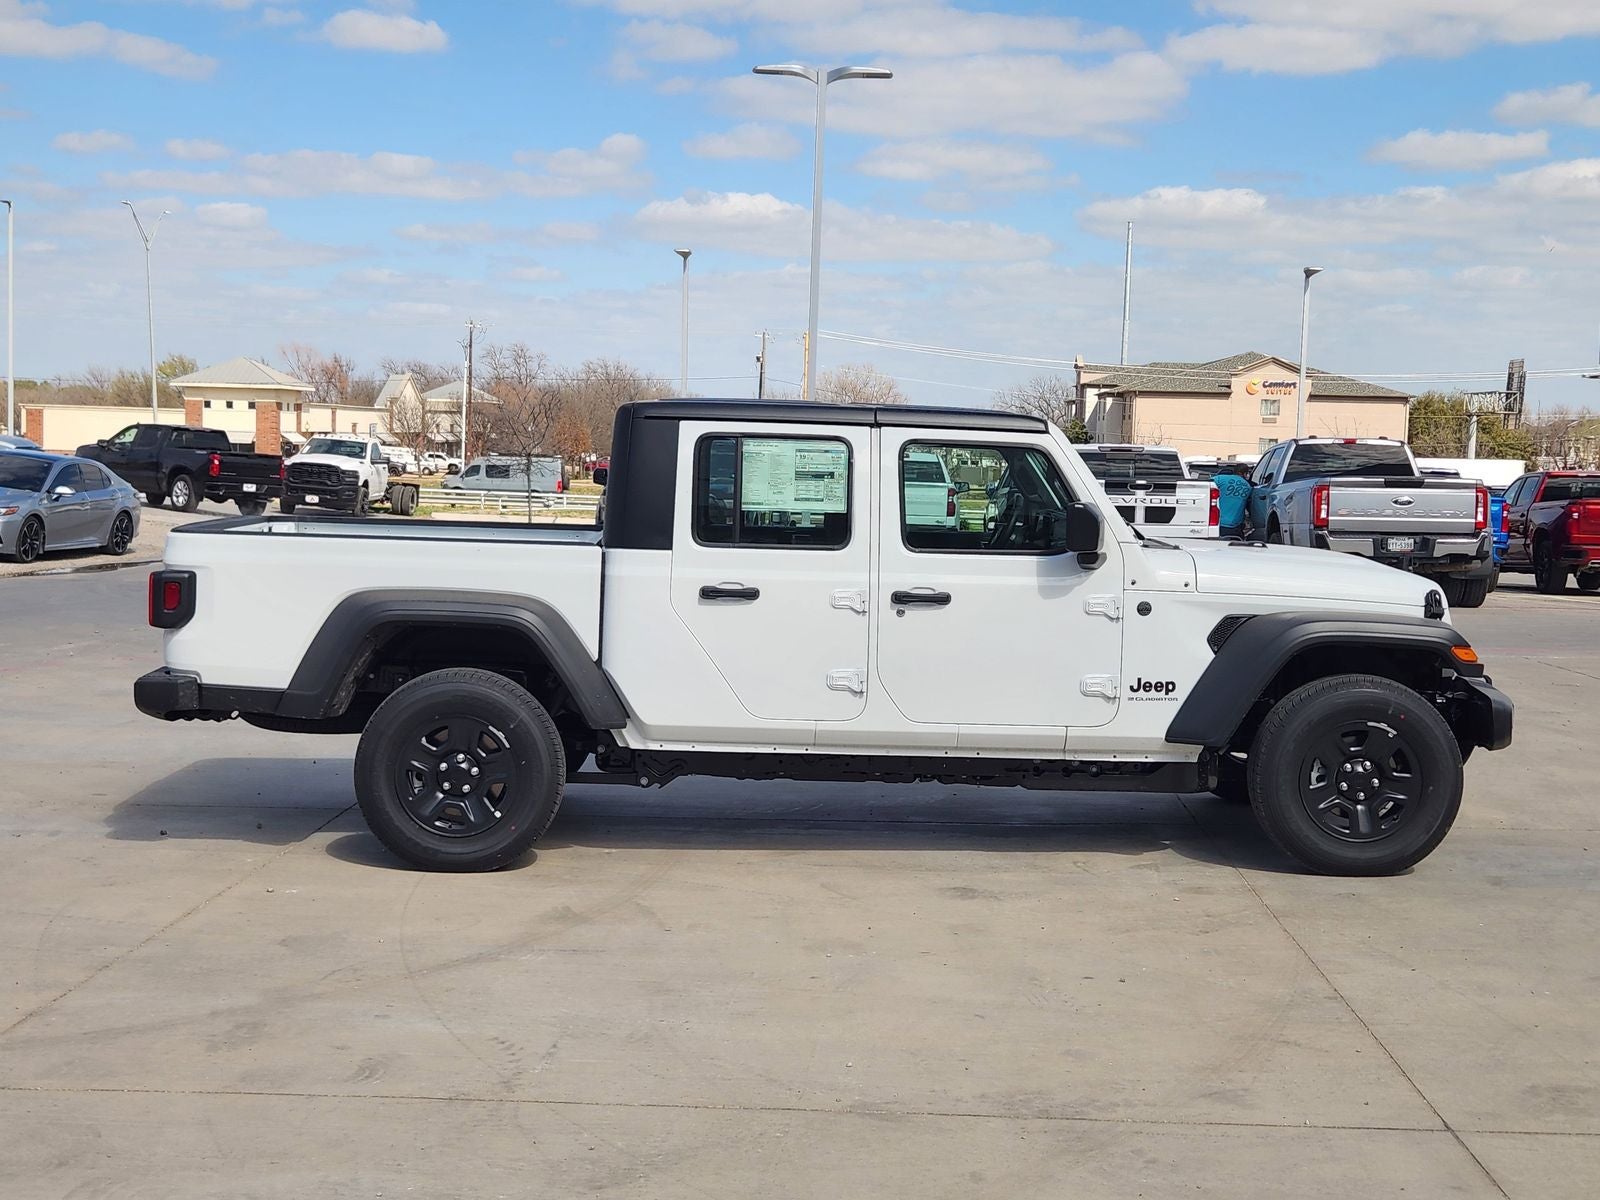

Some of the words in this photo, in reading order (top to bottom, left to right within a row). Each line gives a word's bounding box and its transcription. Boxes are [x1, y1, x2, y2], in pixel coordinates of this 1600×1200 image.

[1262, 380, 1297, 389] Comfort
[1225, 484, 1250, 498] 988
[1109, 497, 1200, 505] EVROLET
[1338, 508, 1408, 516] SUPER
[1413, 509, 1467, 517] DUTY
[1129, 677, 1176, 696] Jeep
